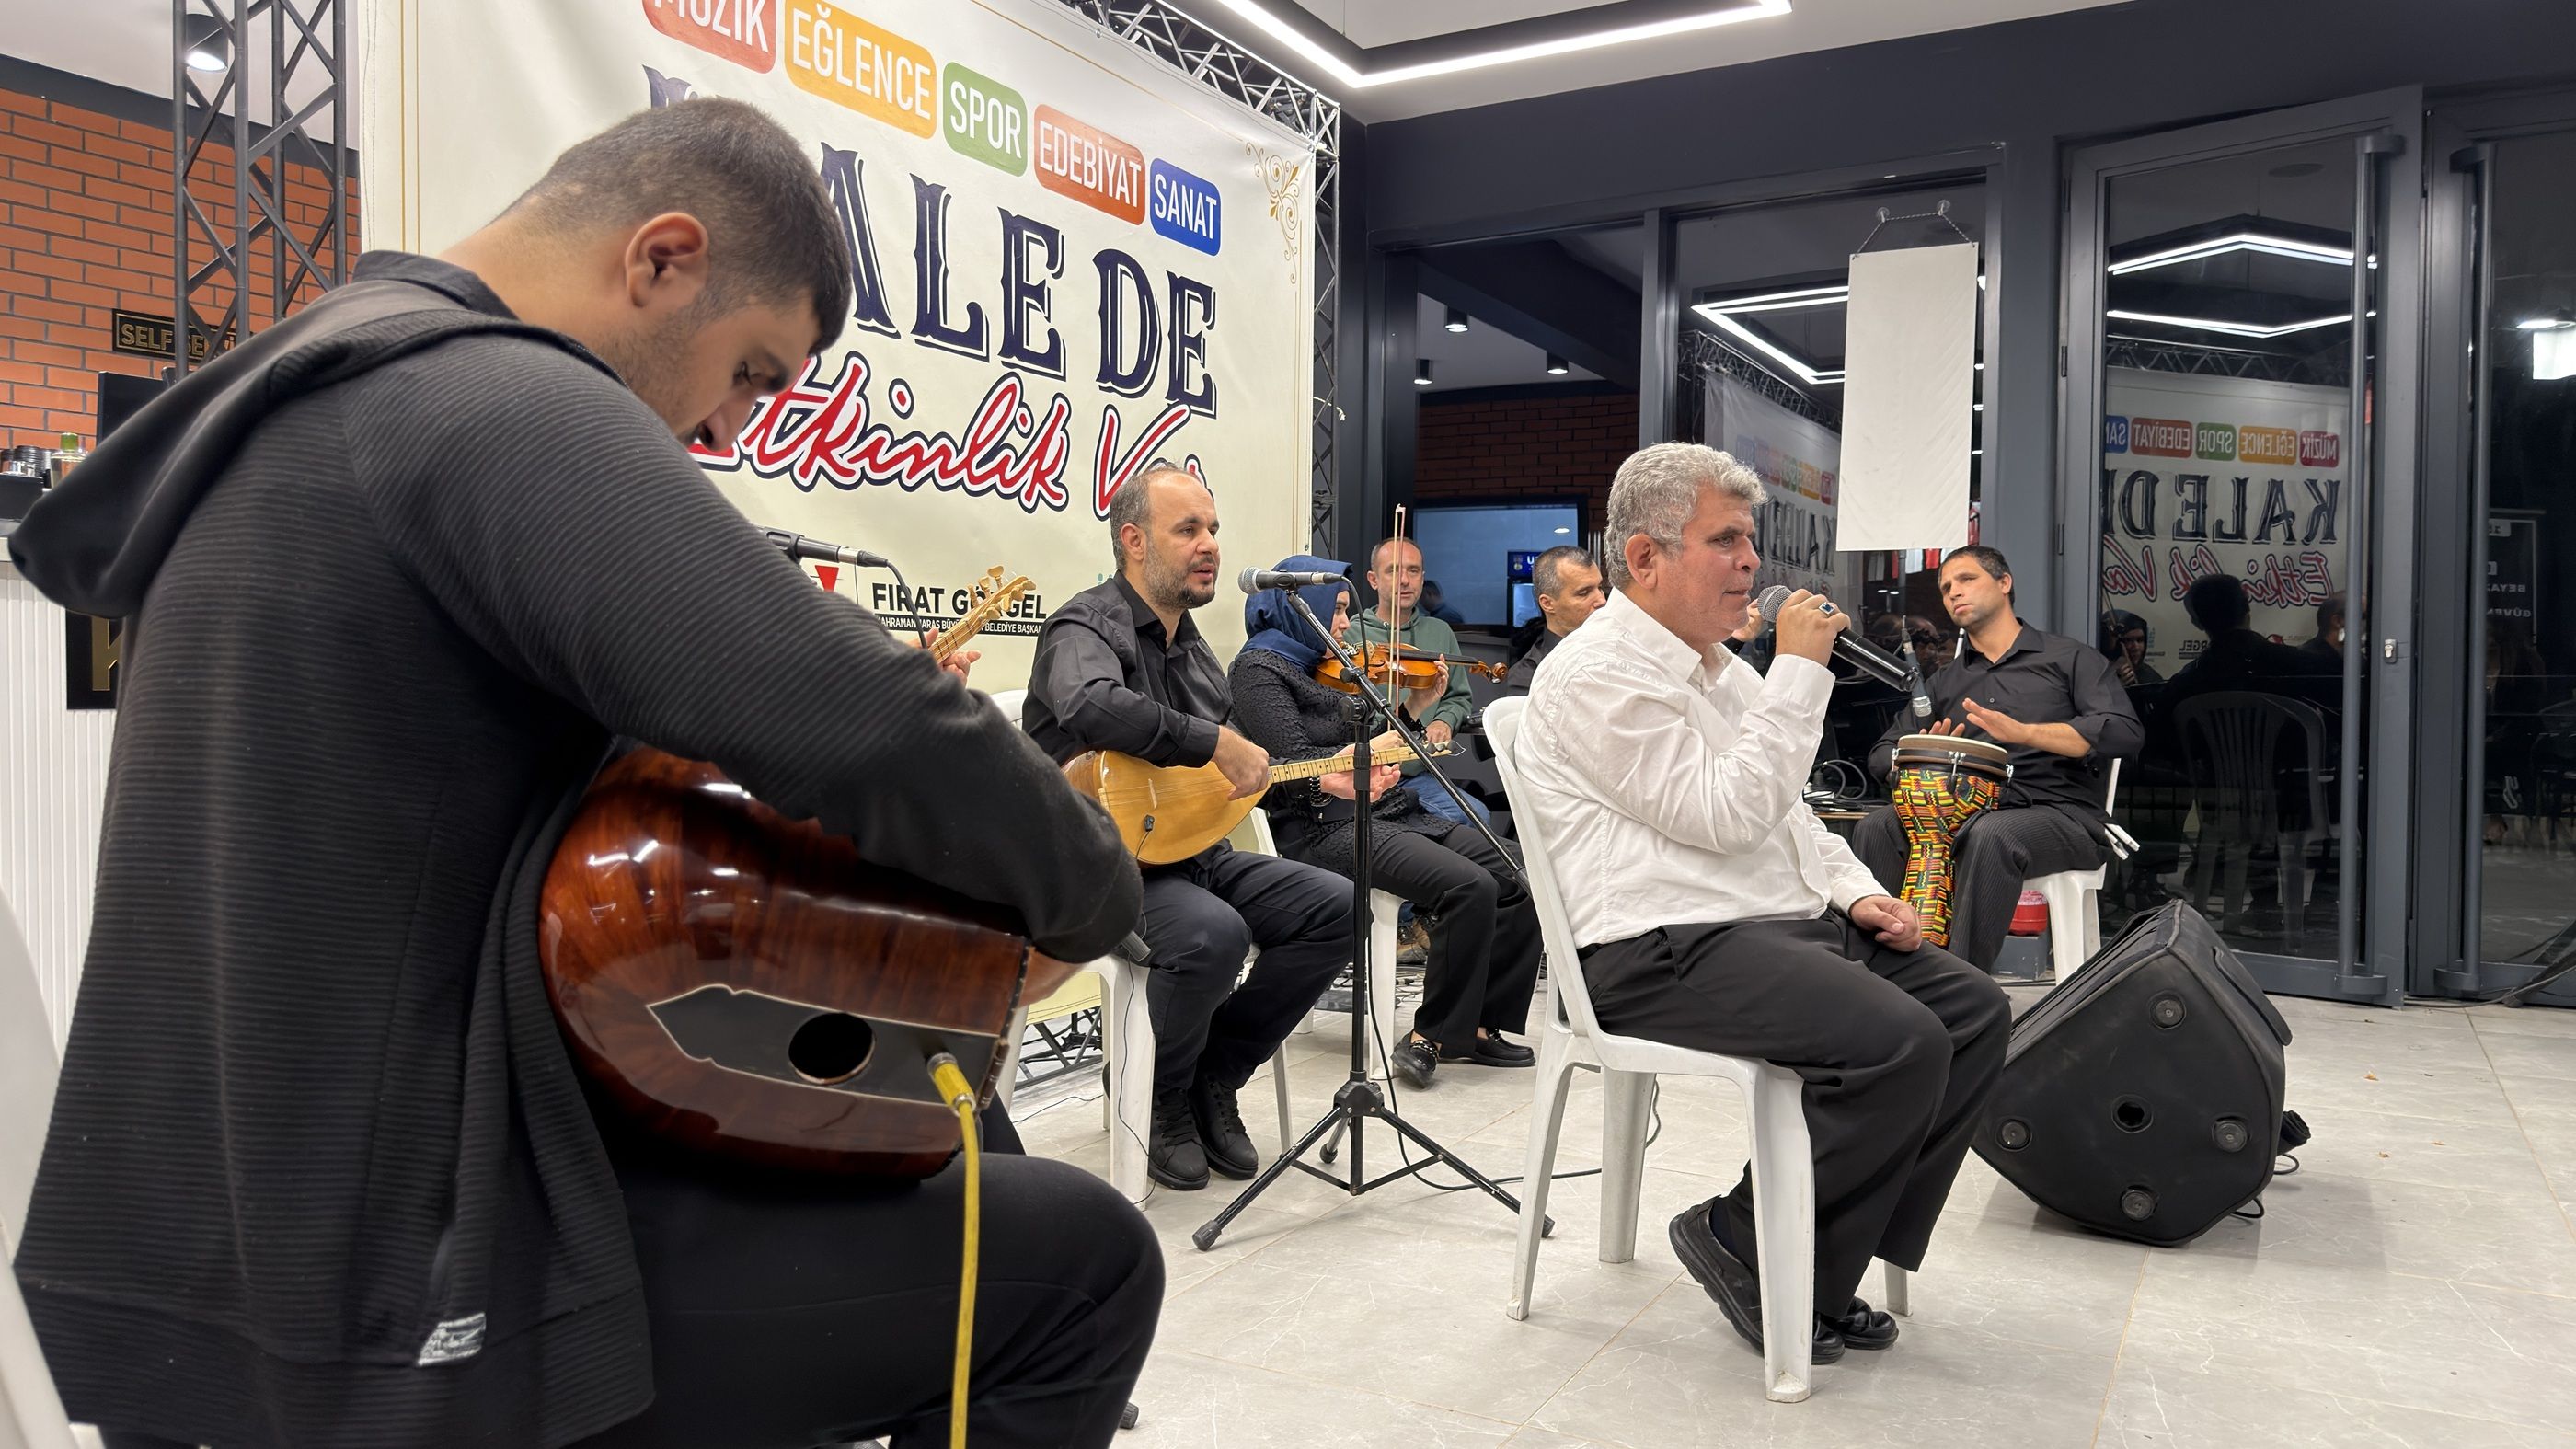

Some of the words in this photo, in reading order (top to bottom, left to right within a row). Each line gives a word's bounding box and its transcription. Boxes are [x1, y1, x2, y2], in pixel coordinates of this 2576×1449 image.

[793, 4, 931, 121] EĞLENCE
[949, 81, 1022, 160] SPOR
[1039, 121, 1142, 209] EDEBİYAT
[1153, 174, 1218, 240] SANAT
[121, 323, 173, 351] SELF
[1092, 247, 1217, 420] DE
[690, 351, 1070, 513] tkinlik
[872, 582, 945, 615] FIRAT
[984, 622, 1017, 634] BELEDİYE
